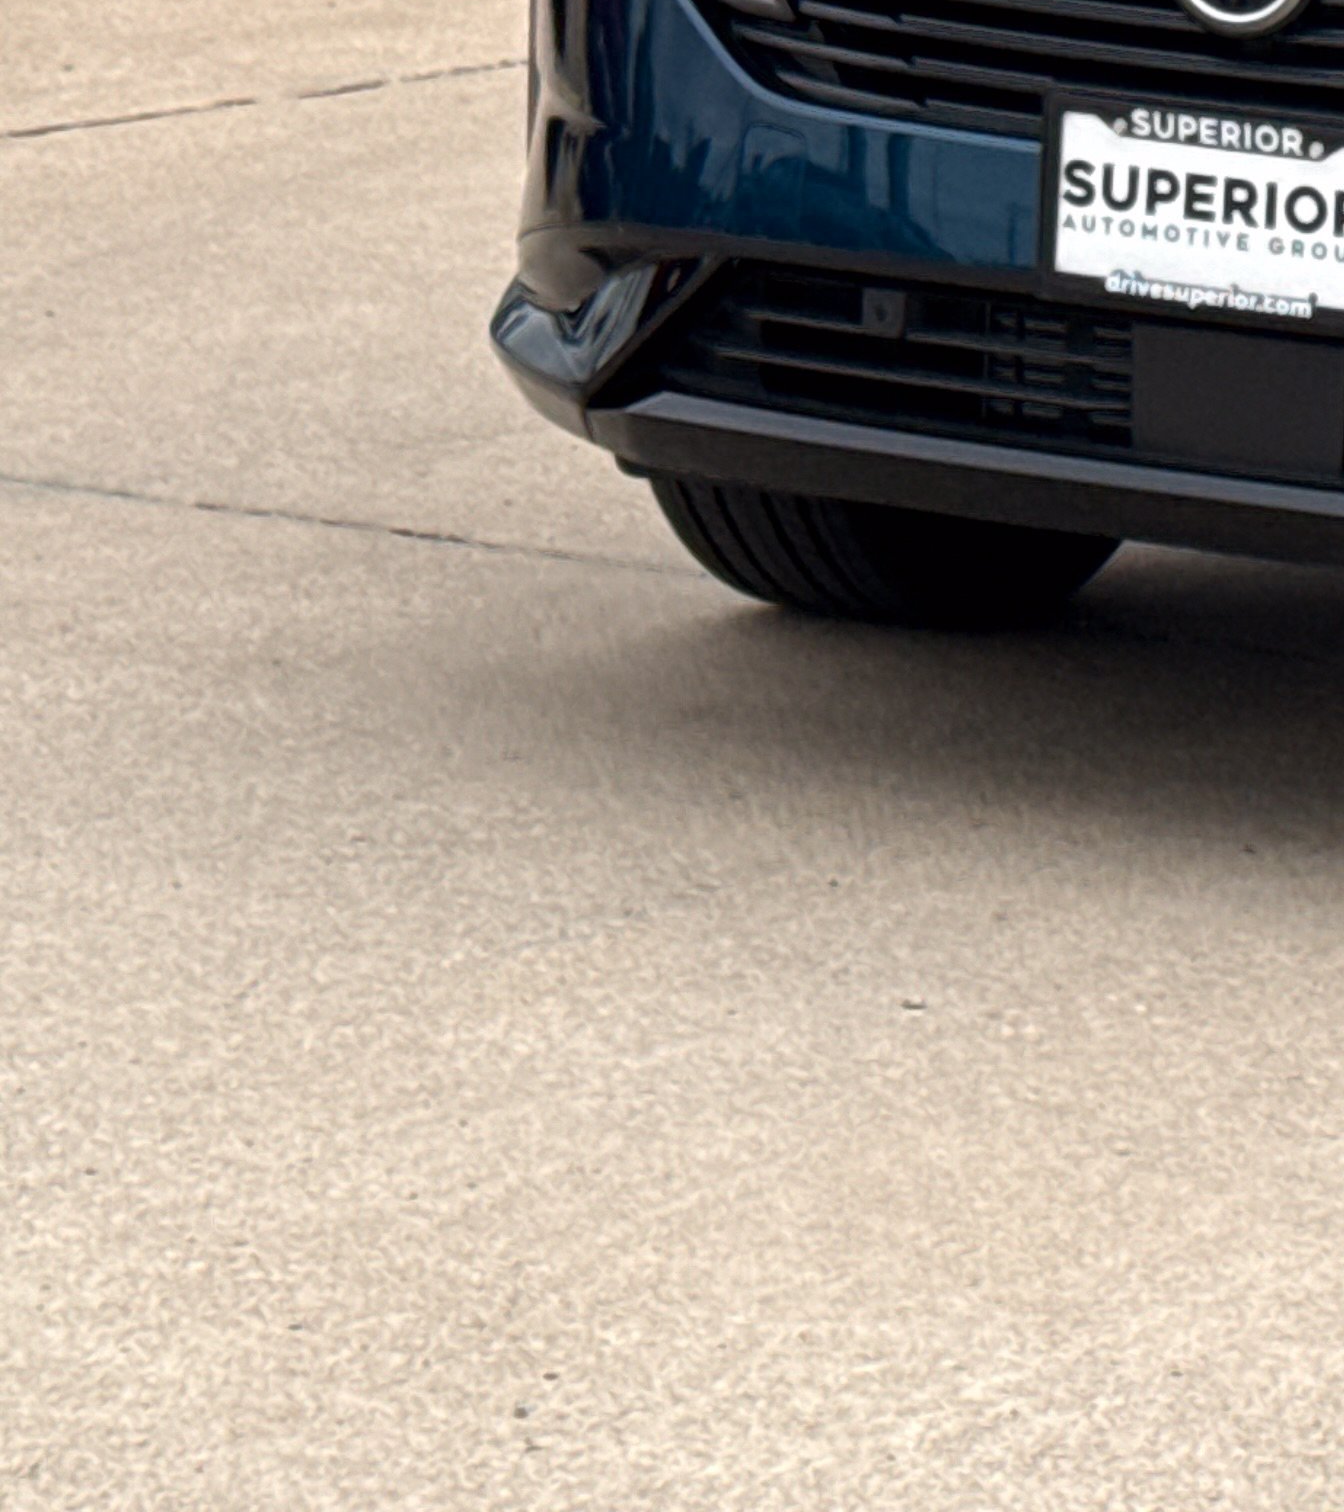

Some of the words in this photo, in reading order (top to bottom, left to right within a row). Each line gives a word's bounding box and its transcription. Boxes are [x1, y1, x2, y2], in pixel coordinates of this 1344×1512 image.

[1131, 108, 1304, 157] SUPERIOR
[1062, 214, 1250, 252] AUTOMOTIVE
[1104, 272, 1313, 319] drivesuperior.com
